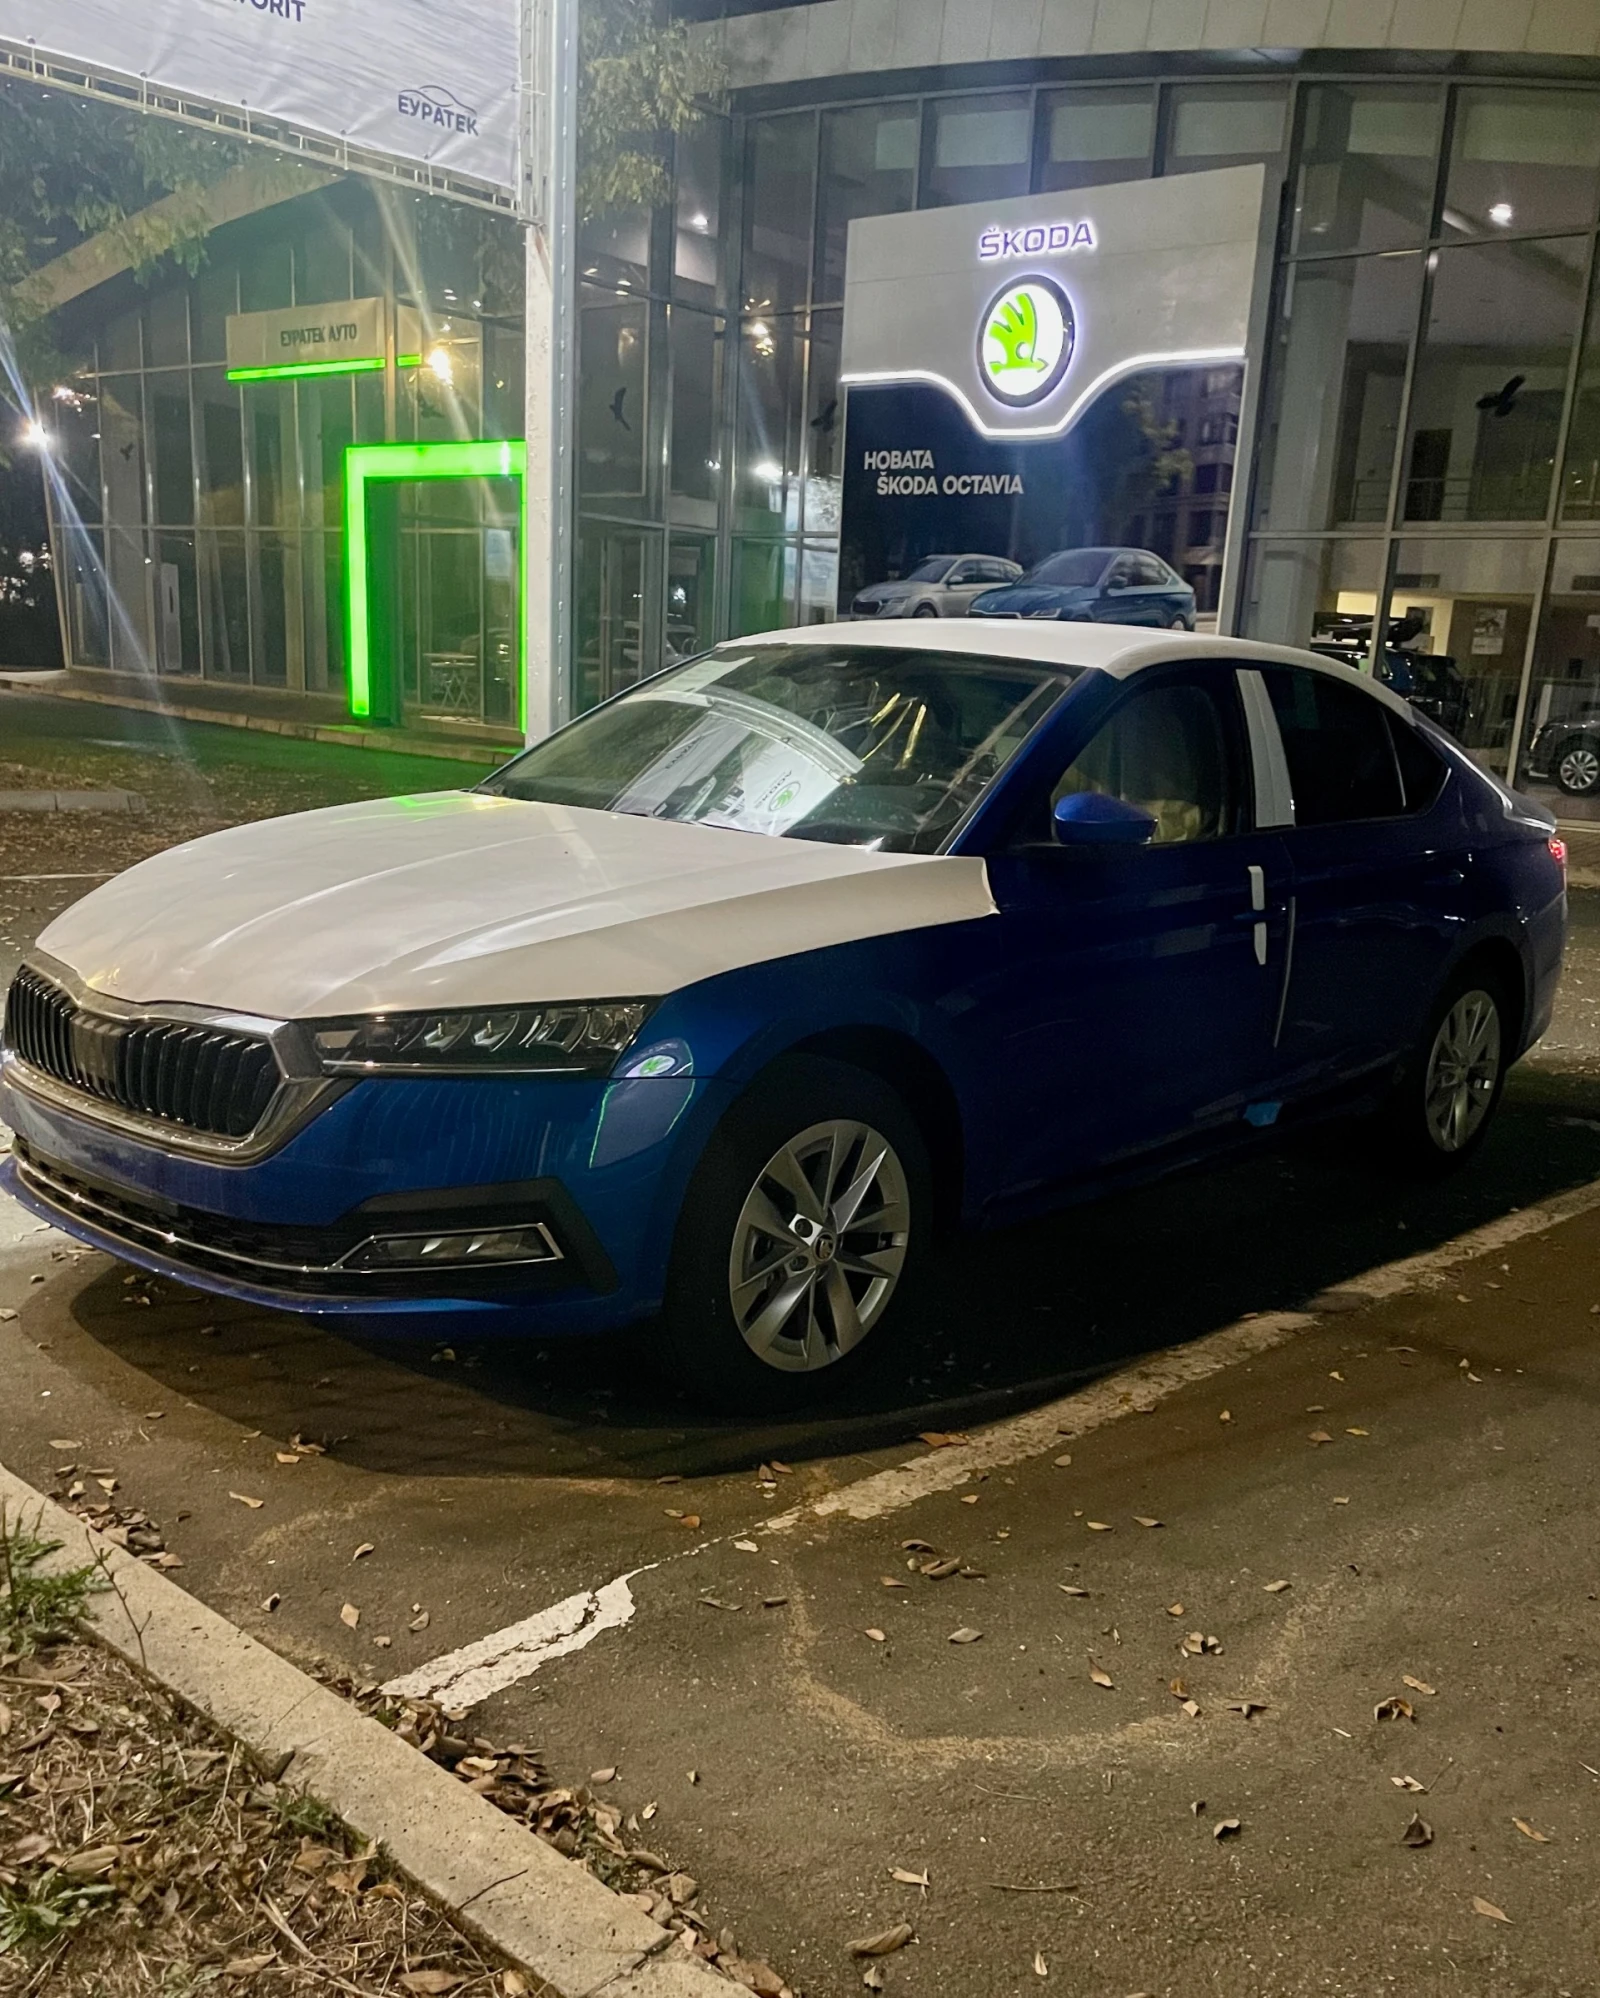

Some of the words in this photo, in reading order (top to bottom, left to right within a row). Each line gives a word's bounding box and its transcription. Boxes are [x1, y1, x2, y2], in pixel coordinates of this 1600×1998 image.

[233, 0, 306, 22] ORIT
[398, 94, 479, 136] ЕУРАТЕК
[980, 222, 1093, 258] ŠKODA
[863, 450, 935, 471] НОВАТА
[876, 470, 939, 496] ŠKODA
[942, 474, 1025, 495] OCTAVIA
